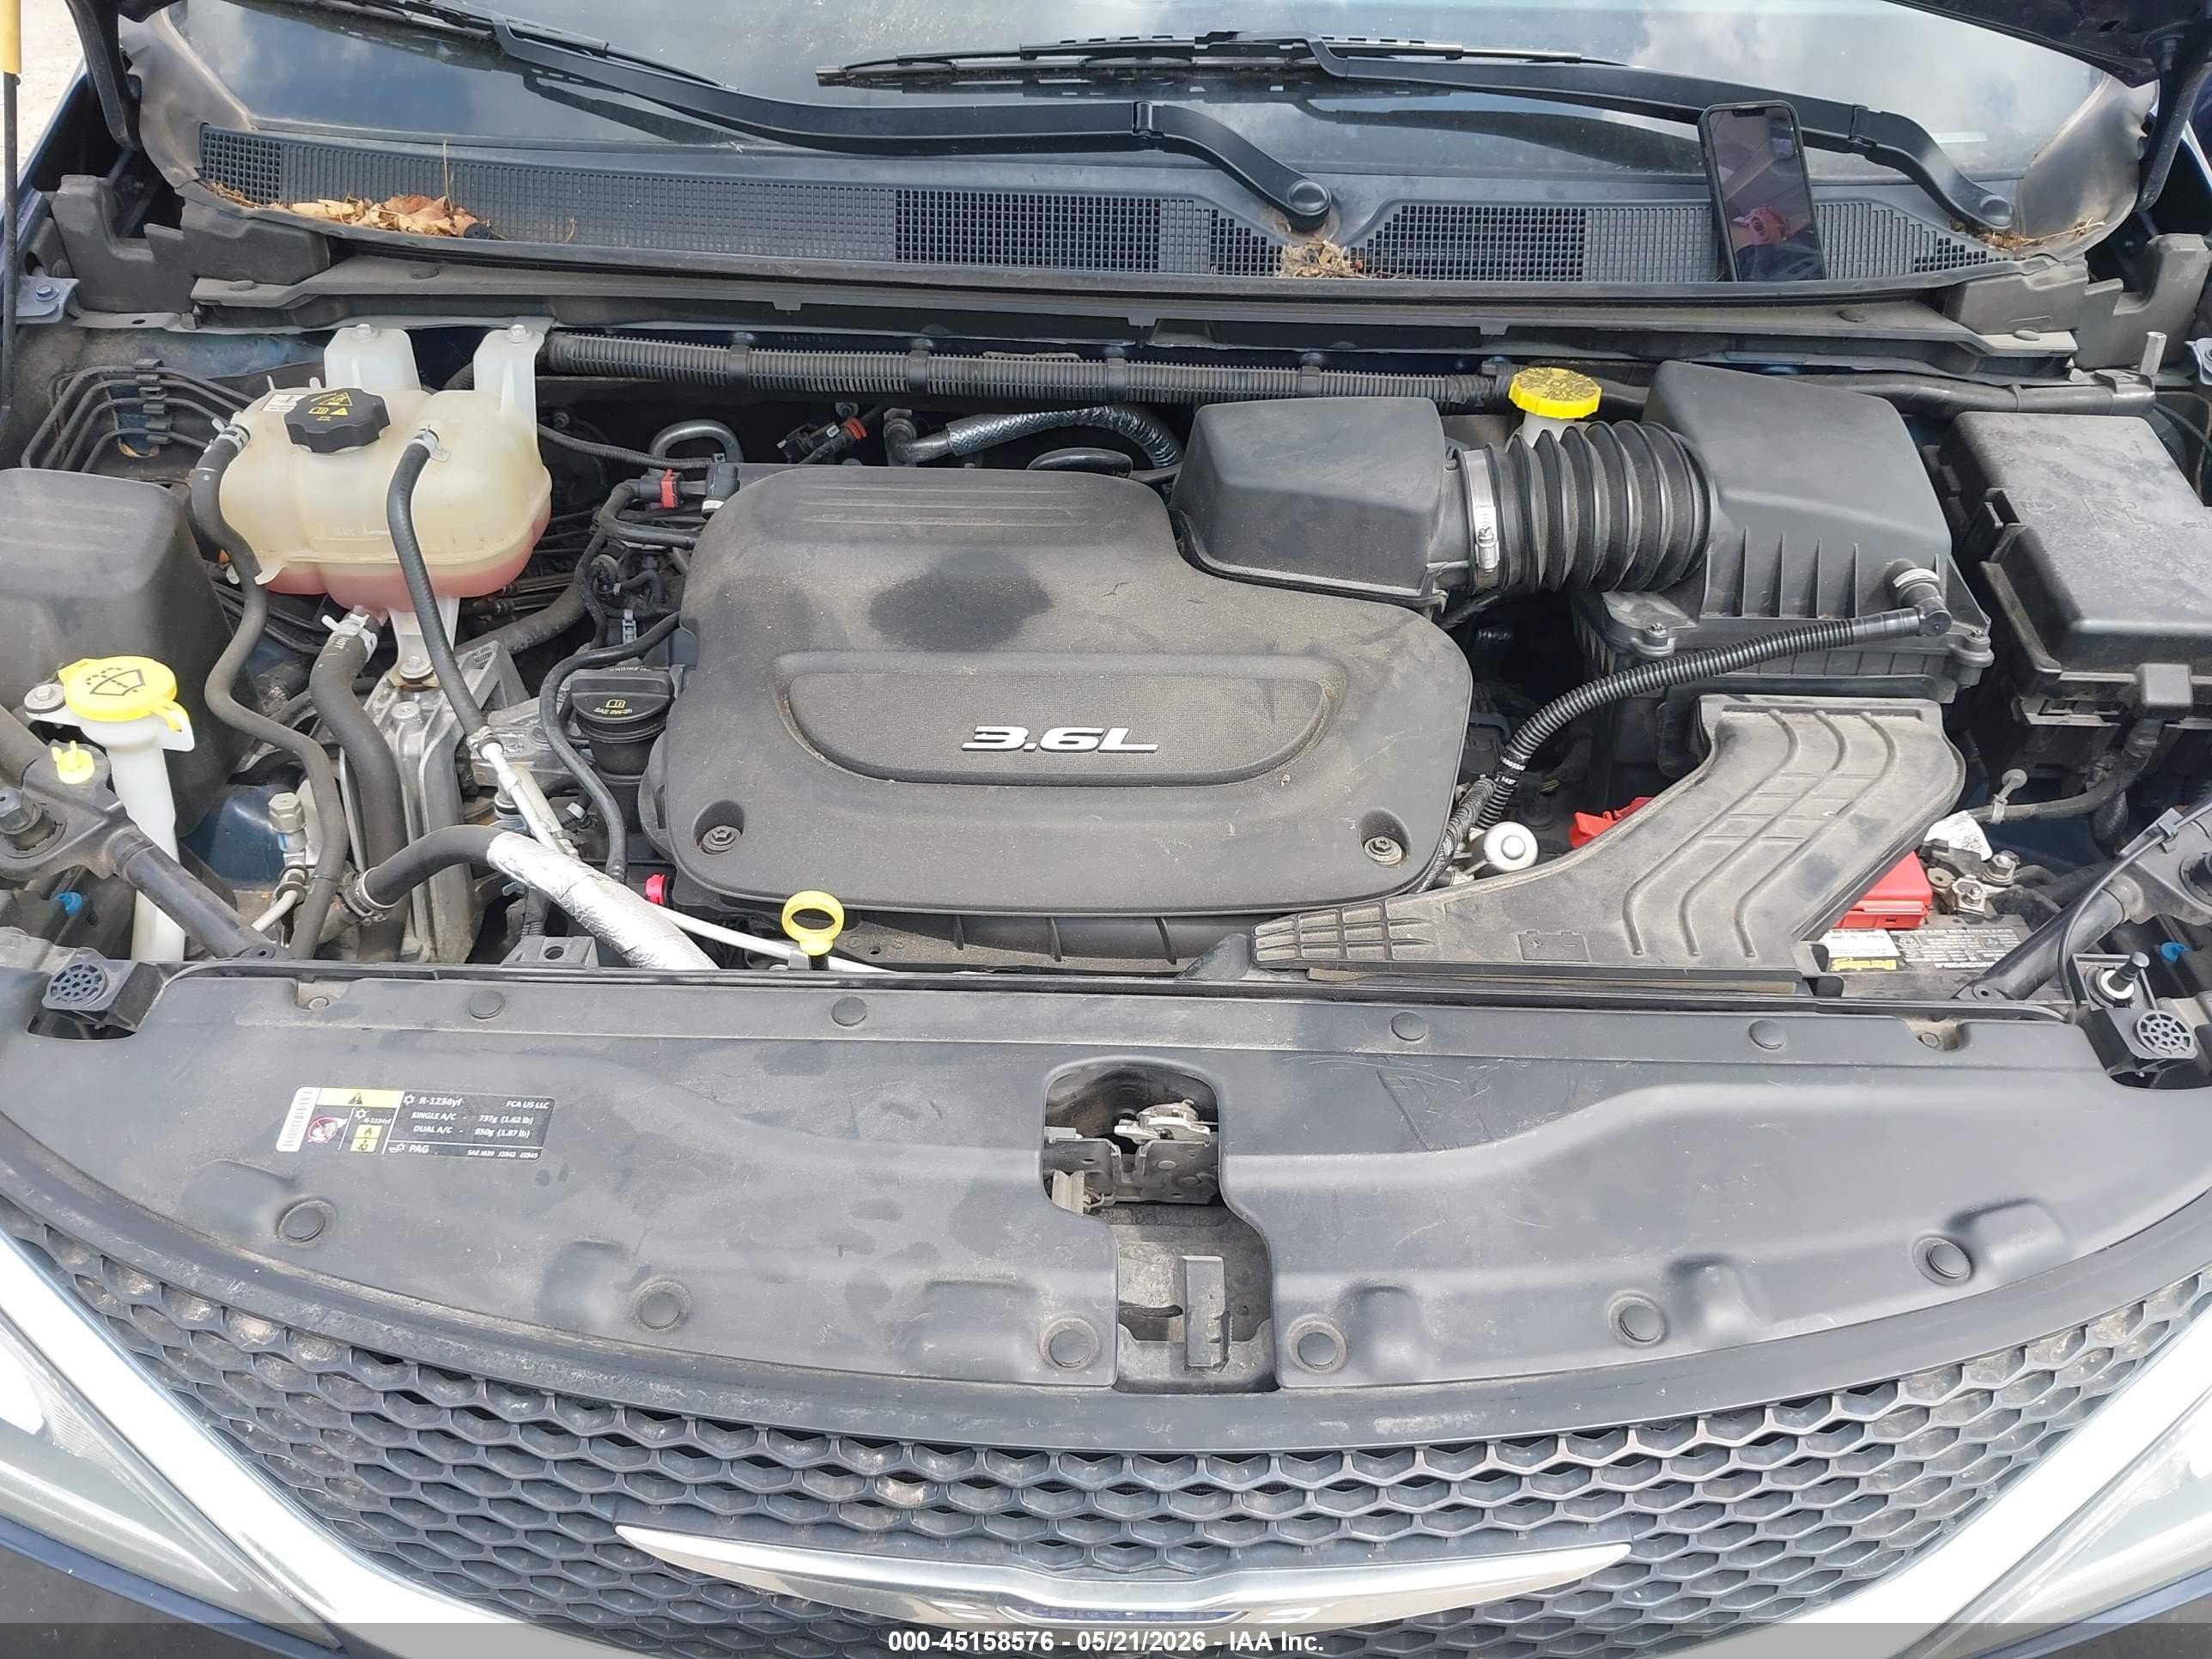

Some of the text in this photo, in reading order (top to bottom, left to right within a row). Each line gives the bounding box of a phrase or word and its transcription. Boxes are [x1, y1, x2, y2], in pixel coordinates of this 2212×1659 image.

[962, 726, 1159, 753] 3.6L
[419, 1097, 463, 1108] R-1234yf
[506, 1100, 522, 1109] FCA
[411, 1111, 441, 1120] SINGLE
[440, 1112, 458, 1121] A/C
[501, 1115, 522, 1124] (1.62
[522, 1115, 534, 1125] lb)
[413, 1125, 436, 1133] DUAL
[436, 1126, 453, 1134] A/C
[497, 1128, 518, 1138] (1.87
[518, 1129, 531, 1139] lb)
[409, 1145, 430, 1154] PAG
